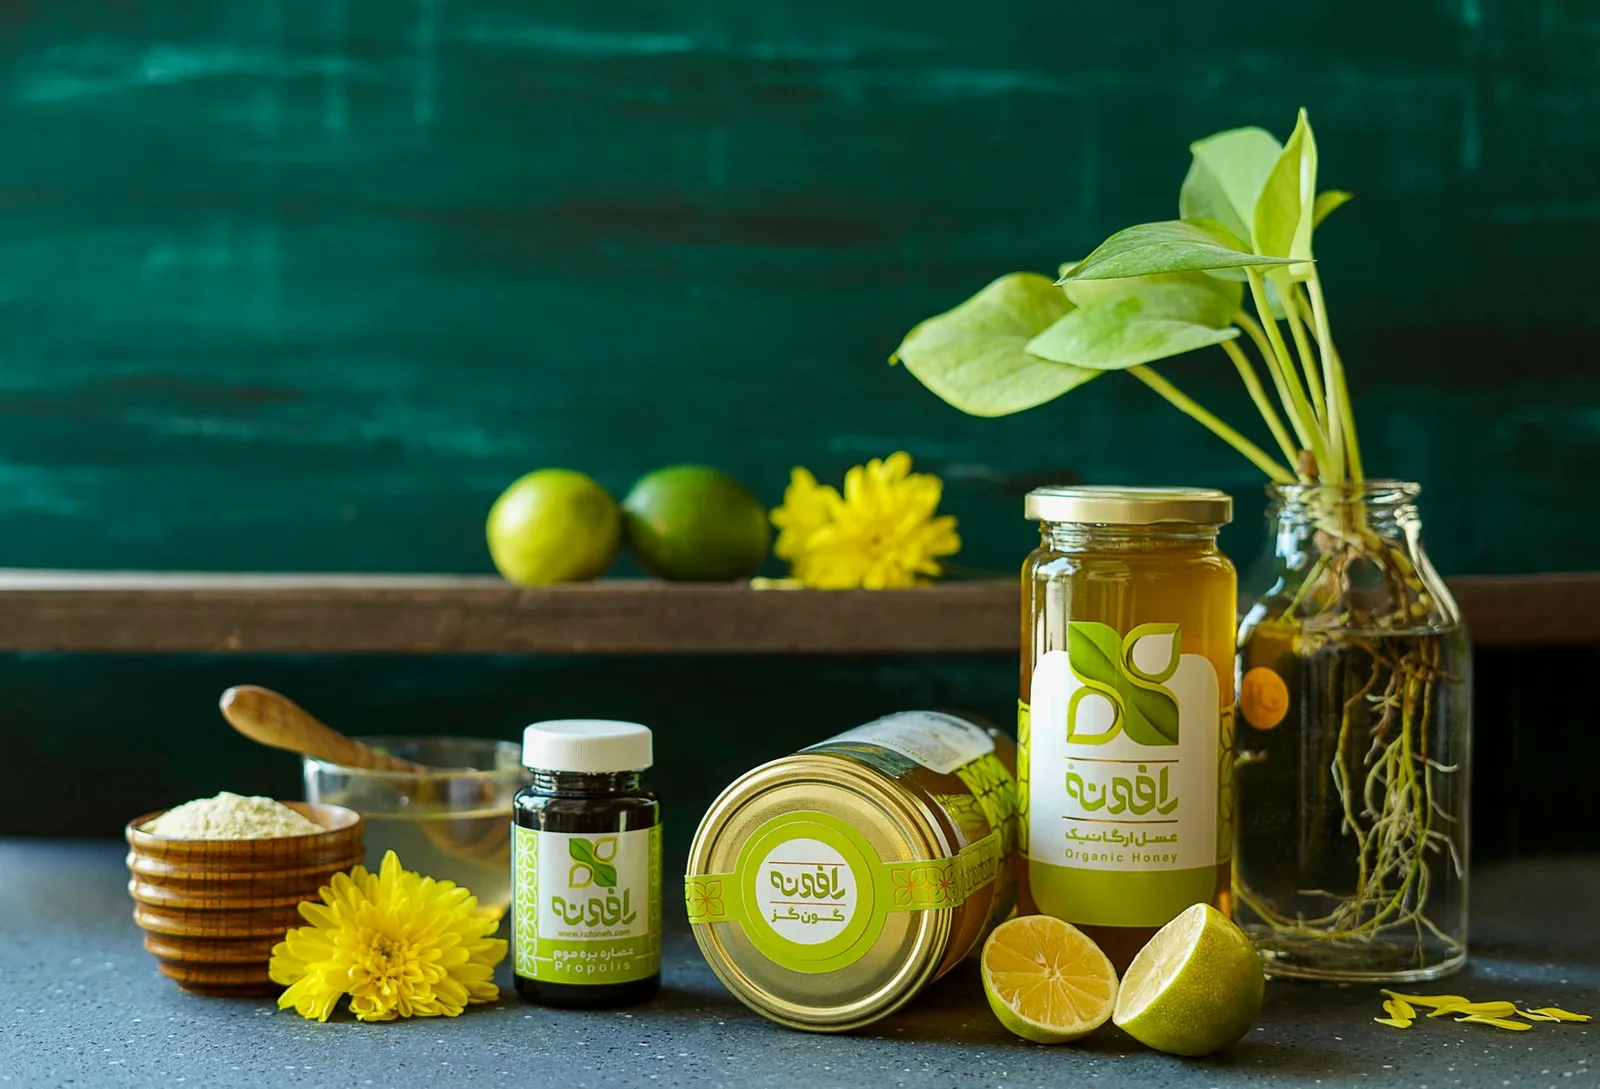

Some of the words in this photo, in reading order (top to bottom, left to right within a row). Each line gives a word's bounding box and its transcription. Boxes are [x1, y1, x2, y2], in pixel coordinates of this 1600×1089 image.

[1135, 831, 1178, 847] عسل
[1065, 848, 1124, 863] Organic
[1132, 852, 1178, 864] Honey
[555, 961, 630, 975] Propolis
